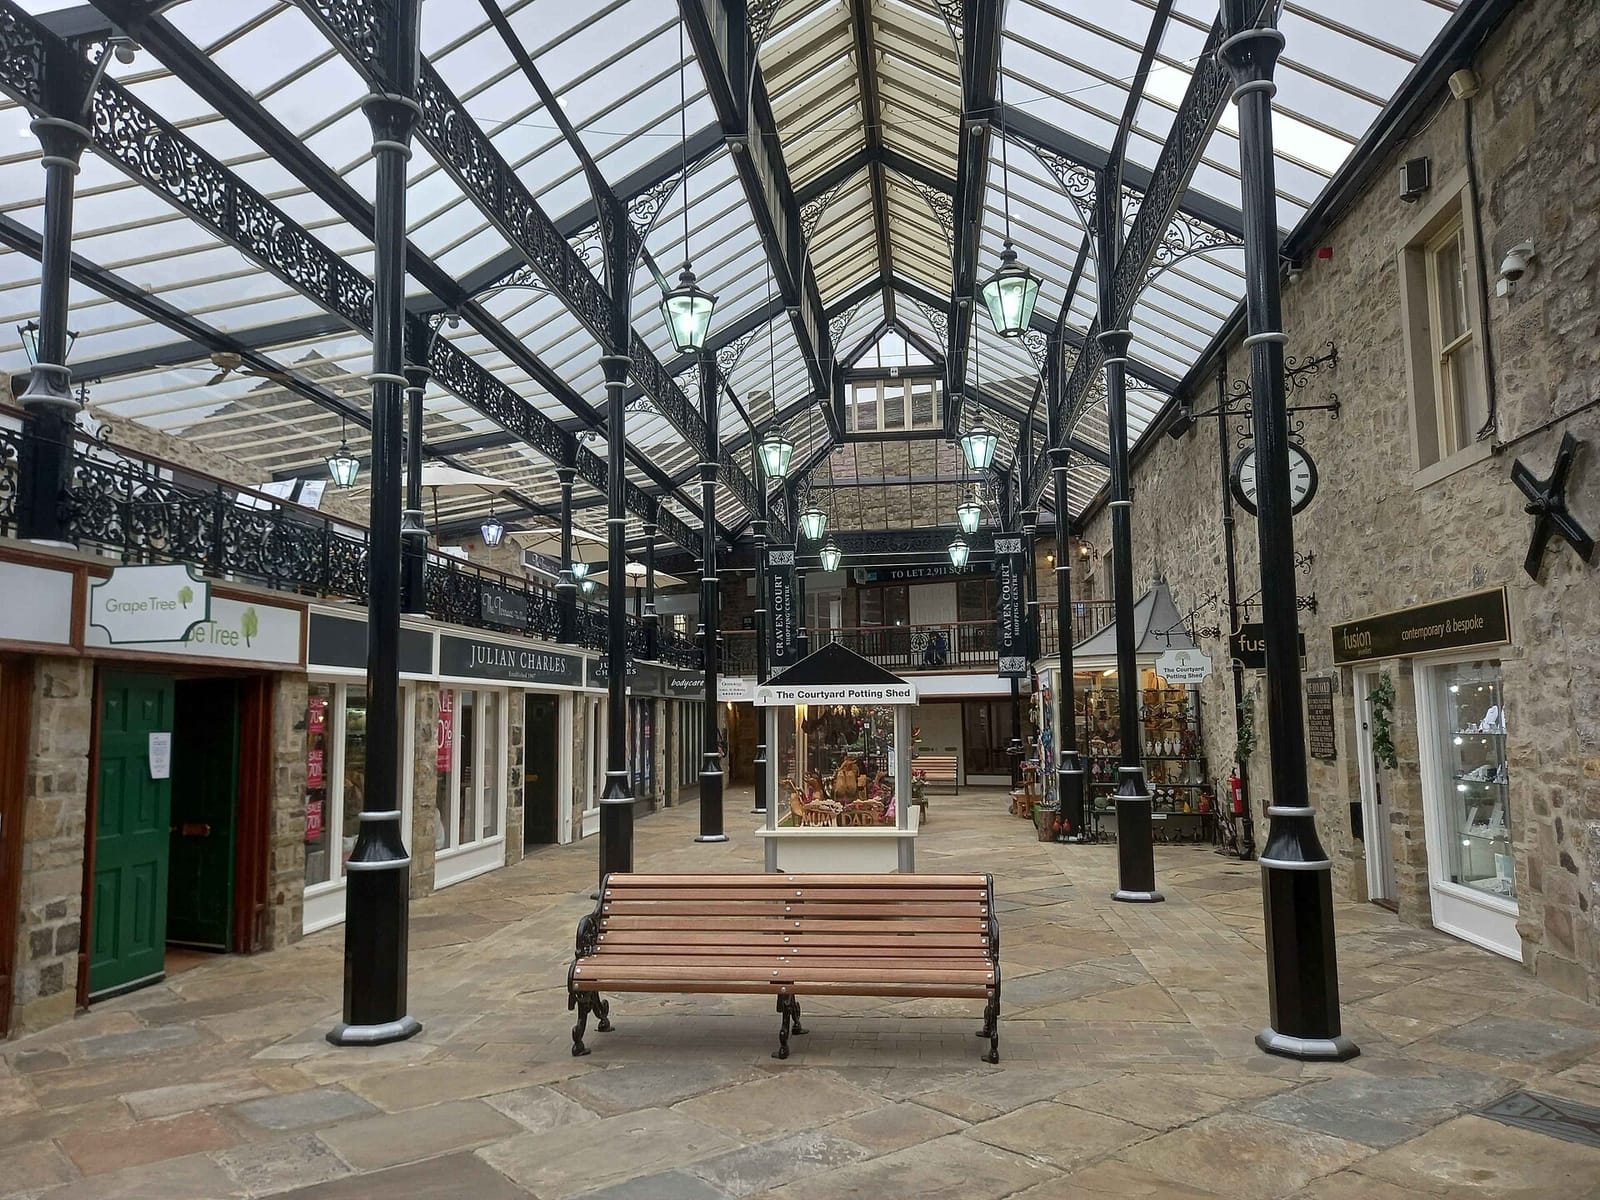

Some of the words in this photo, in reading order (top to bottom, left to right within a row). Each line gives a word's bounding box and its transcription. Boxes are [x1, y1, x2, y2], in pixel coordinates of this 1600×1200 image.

[892, 570, 904, 579] TO
[906, 568, 925, 578] LET
[1001, 563, 1011, 600] COURT
[774, 574, 783, 611] COURT
[105, 598, 147, 615] Grape
[148, 597, 177, 611] Tree
[207, 620, 240, 647] Tree
[1003, 603, 1012, 647] CRAVEN
[1401, 622, 1445, 641] contemporary
[1446, 619, 1451, 633] &
[1452, 614, 1484, 635] bespoke
[775, 613, 784, 657] CRAVEN
[1238, 634, 1266, 652] fus
[1343, 626, 1372, 650] fusion
[469, 645, 516, 668] JULIAN
[520, 652, 566, 673] CHARLES
[599, 661, 633, 670] JUN
[595, 668, 637, 676] CHES
[671, 678, 705, 689] bodycare
[309, 698, 324, 708] SALE
[776, 690, 795, 699] The
[797, 689, 846, 700] Courtyard
[848, 688, 883, 699] Potting
[885, 688, 911, 698] Shed
[437, 719, 452, 749] 0%
[308, 751, 322, 761] SALE
[306, 802, 321, 813] SALE
